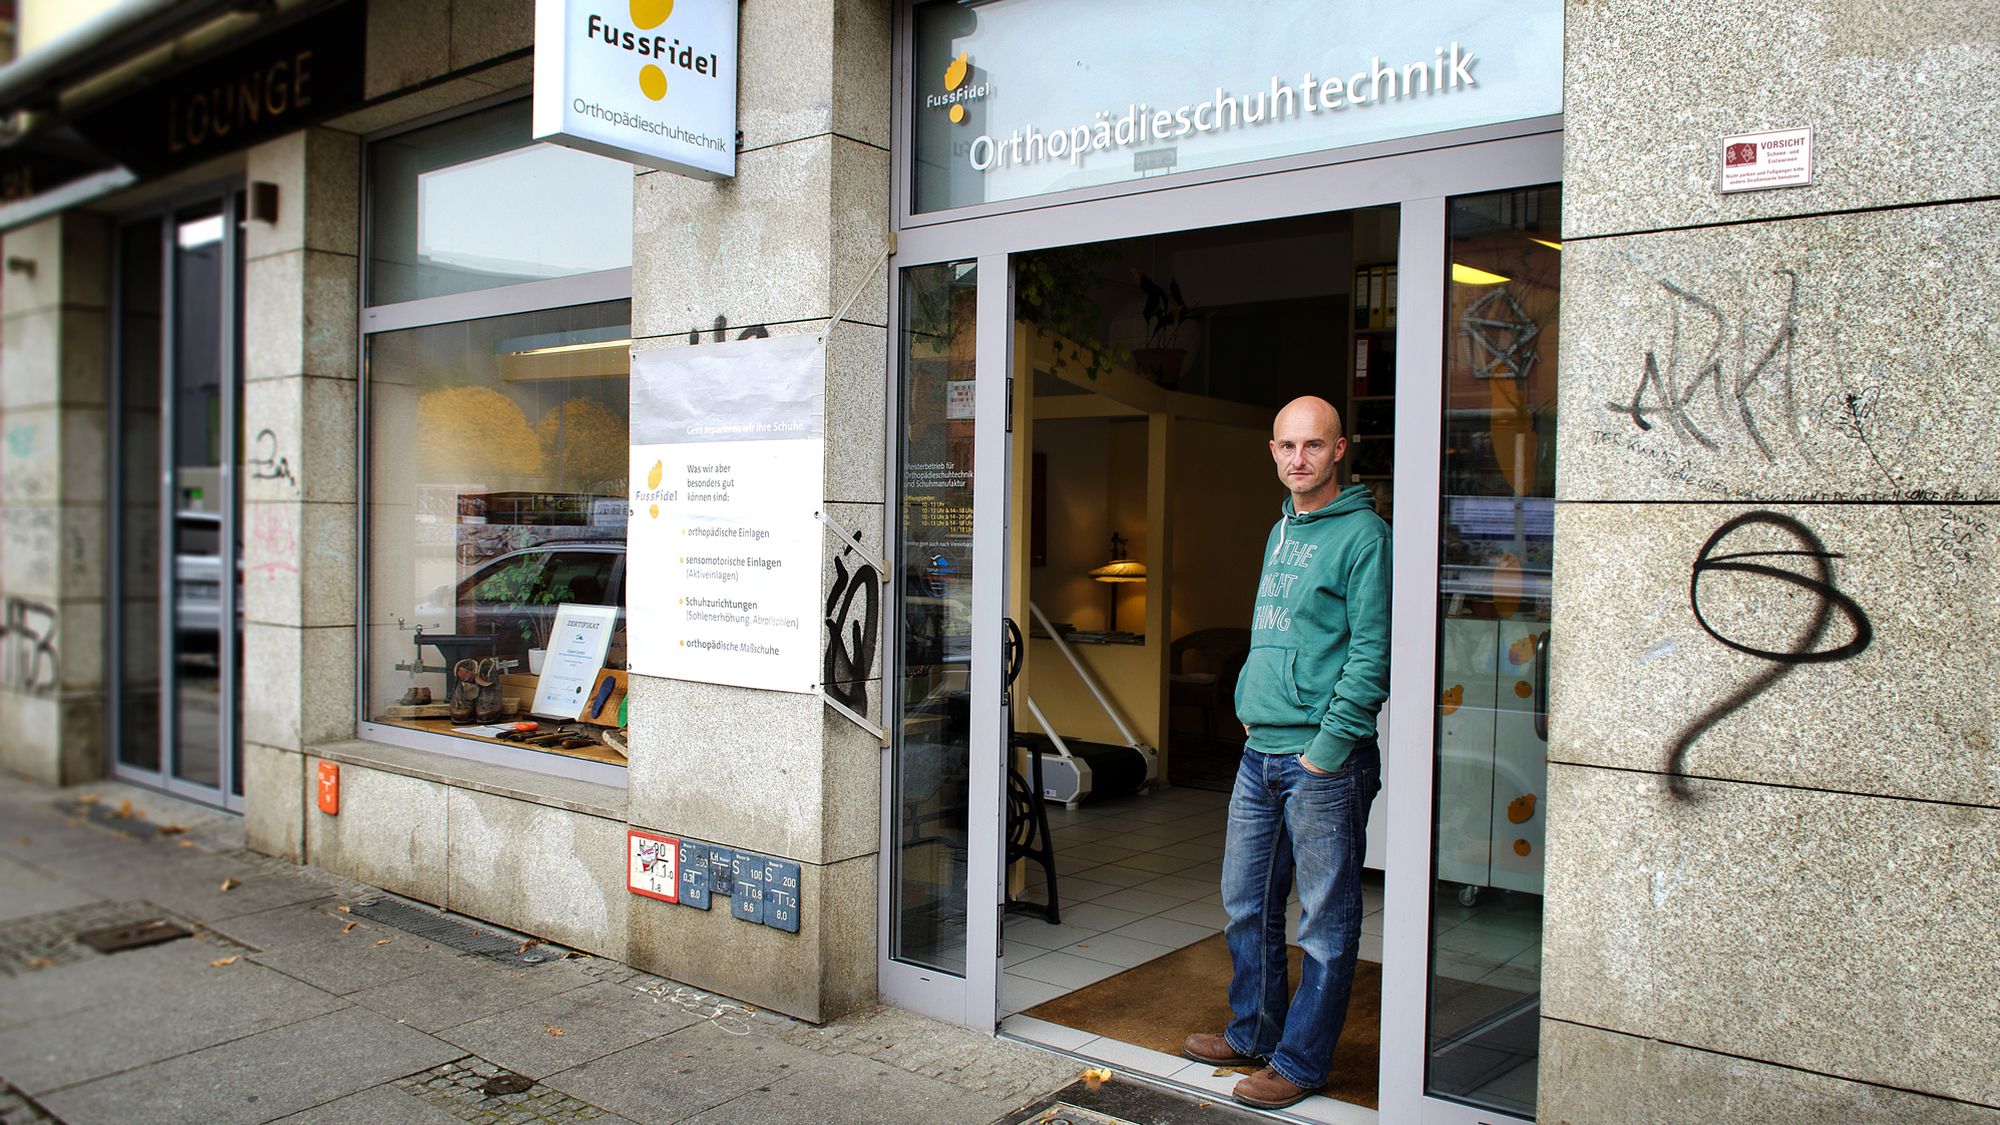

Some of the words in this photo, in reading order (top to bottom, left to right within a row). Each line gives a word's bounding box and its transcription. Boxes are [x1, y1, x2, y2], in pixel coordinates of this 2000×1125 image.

[169, 50, 313, 150] LOUNGE
[969, 41, 1478, 171] Orthopädieschuhtechnik
[573, 98, 727, 153] Orthopädieschuhtechnik
[1761, 137, 1805, 150] VORSICHT
[687, 425, 703, 436] Gern
[756, 422, 772, 432] Ihre
[687, 464, 701, 474] Was
[702, 464, 714, 473] wir
[715, 463, 731, 473] aber
[687, 478, 721, 488] besonders
[722, 478, 735, 490] gut
[687, 492, 712, 502] können
[713, 492, 730, 502] sind:
[687, 526, 738, 539] orthopädische
[738, 527, 770, 541] Einlagen
[1281, 539, 1318, 568] THE
[686, 555, 746, 567] sensomotorische
[746, 557, 782, 570] Einlagen
[685, 597, 757, 612] Schuhzurichtungen
[567, 620, 600, 630] ZERTIFIKAT
[686, 639, 739, 652] orthopädische
[739, 643, 780, 656] Maßschuhe
[680, 848, 687, 863] S
[732, 860, 740, 875] S
[750, 868, 763, 881] 100
[765, 866, 773, 882] S
[783, 876, 797, 889] 200
